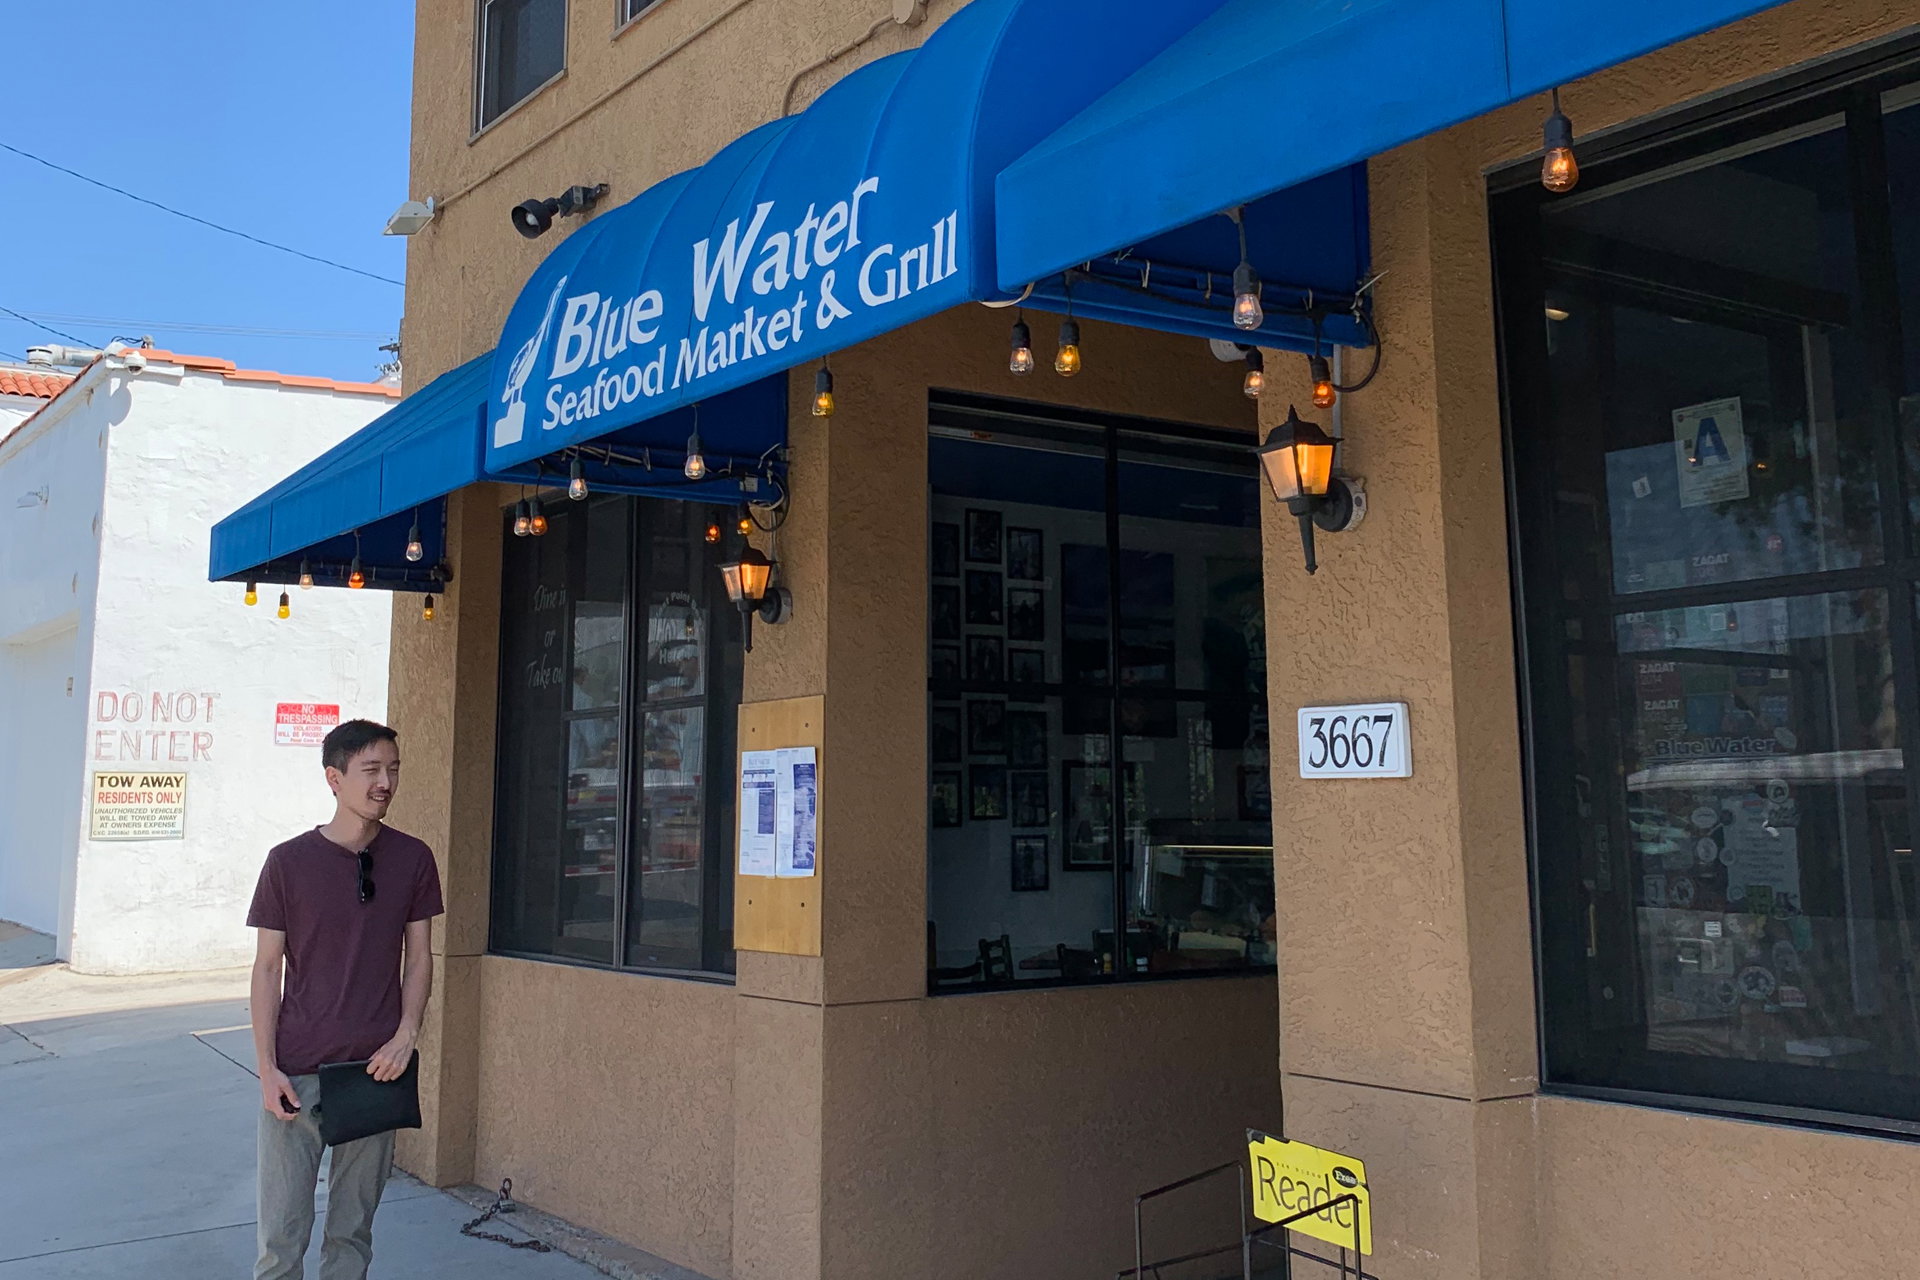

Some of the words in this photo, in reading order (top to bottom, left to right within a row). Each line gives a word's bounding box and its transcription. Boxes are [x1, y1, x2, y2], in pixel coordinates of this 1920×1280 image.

[548, 290, 663, 380] Blue
[692, 176, 879, 322] Water
[542, 344, 666, 431] Seafood
[671, 290, 809, 389] Market
[816, 269, 853, 330] &
[858, 209, 958, 307] Grill
[1692, 417, 1731, 467] A
[1692, 552, 1730, 567] ZAGAT
[534, 584, 558, 612] Dine
[544, 630, 556, 648] or
[527, 653, 551, 690] Take
[552, 666, 564, 684] ou
[96, 691, 143, 723] DO
[152, 691, 221, 723] NOT
[278, 714, 338, 724] TRESPASSING
[302, 704, 316, 714] NO
[94, 730, 214, 762] ENTER
[1308, 713, 1393, 768] 3667
[97, 775, 135, 788] TOW
[140, 775, 184, 788] AWAY
[98, 791, 154, 804] RESIDENTS
[156, 791, 182, 804] ONLY
